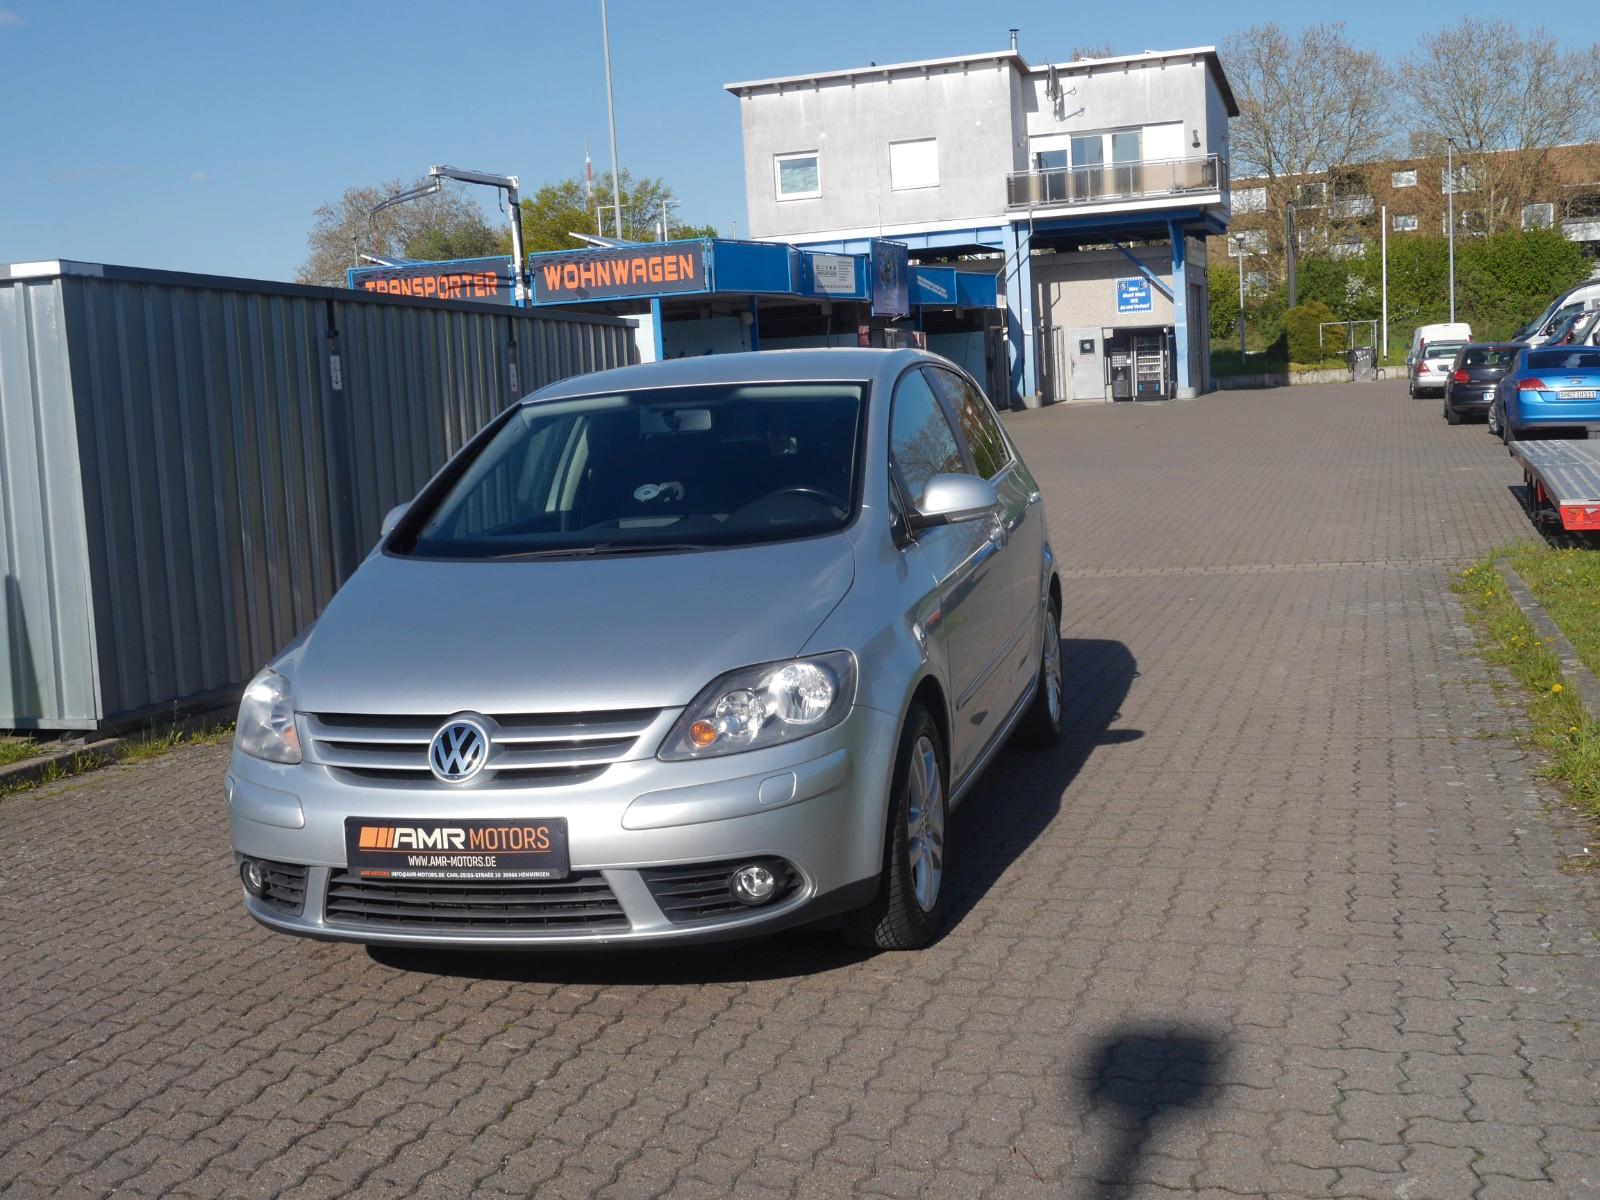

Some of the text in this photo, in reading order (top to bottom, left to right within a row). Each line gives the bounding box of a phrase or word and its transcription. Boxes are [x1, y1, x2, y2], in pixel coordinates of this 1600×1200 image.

[543, 254, 694, 291] WOHNWAGEN
[393, 826, 550, 850] AMR MOTORS
[408, 855, 497, 868] WWW.AMR-MOTORS.DE
